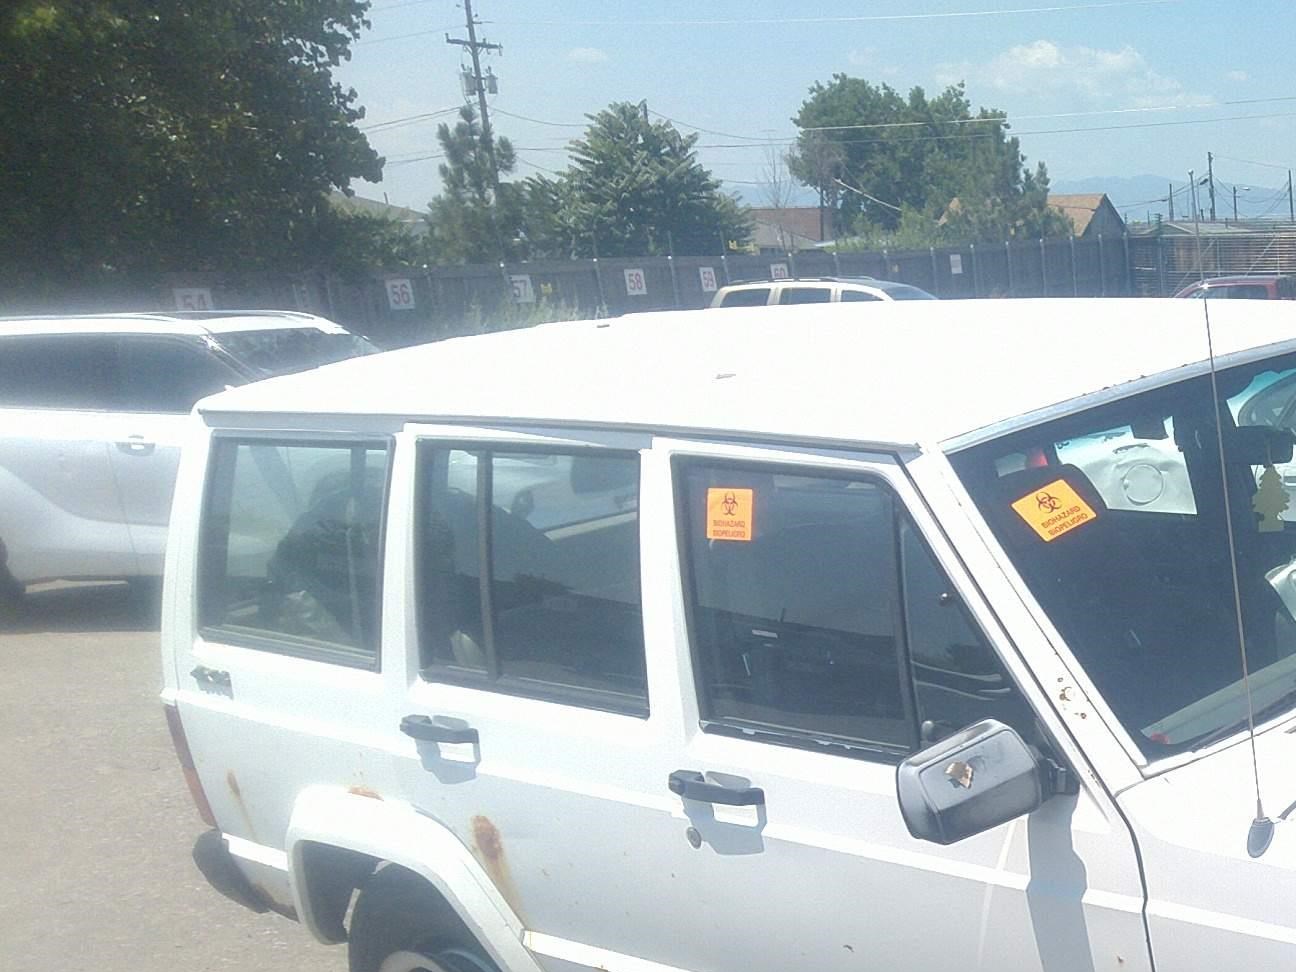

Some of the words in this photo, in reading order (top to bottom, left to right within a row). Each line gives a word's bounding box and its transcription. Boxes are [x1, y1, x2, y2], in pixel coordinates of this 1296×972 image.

[512, 279, 529, 298] 57
[627, 275, 643, 290] 58
[701, 273, 714, 288] 59
[392, 284, 410, 304] 56
[712, 519, 746, 528] BIOHAZARD
[1041, 505, 1081, 529] BIOHAZARD
[1048, 513, 1089, 536] BIOPELIGRO
